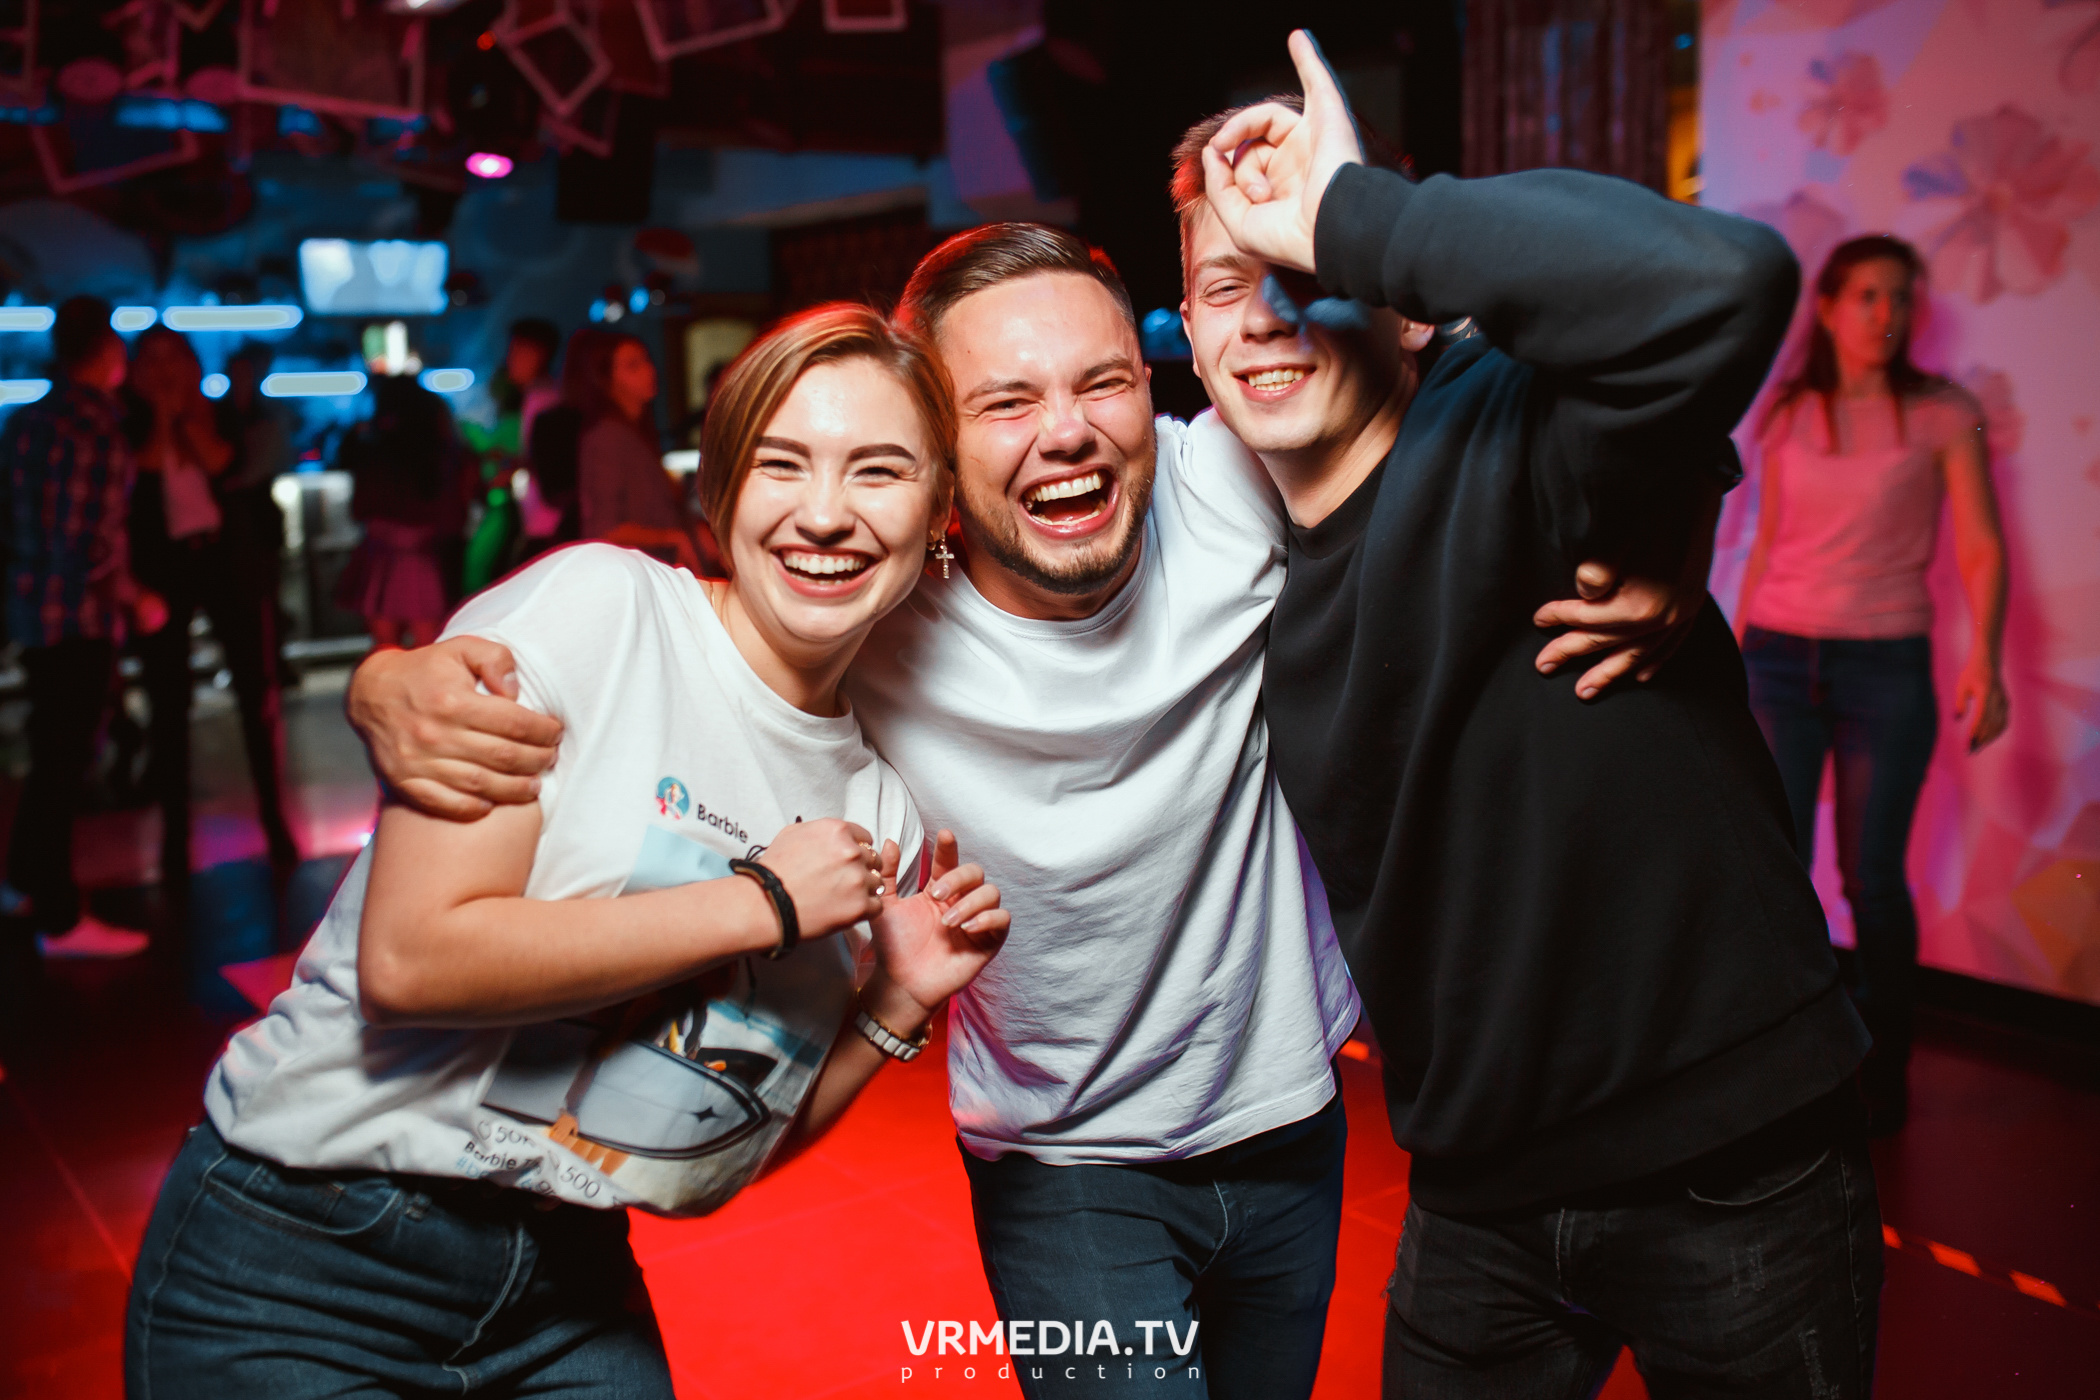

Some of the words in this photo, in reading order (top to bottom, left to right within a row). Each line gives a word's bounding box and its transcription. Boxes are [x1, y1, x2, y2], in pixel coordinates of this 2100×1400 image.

[696, 803, 748, 844] Barbie
[463, 1140, 517, 1170] Barbie
[560, 1166, 601, 1199] 500
